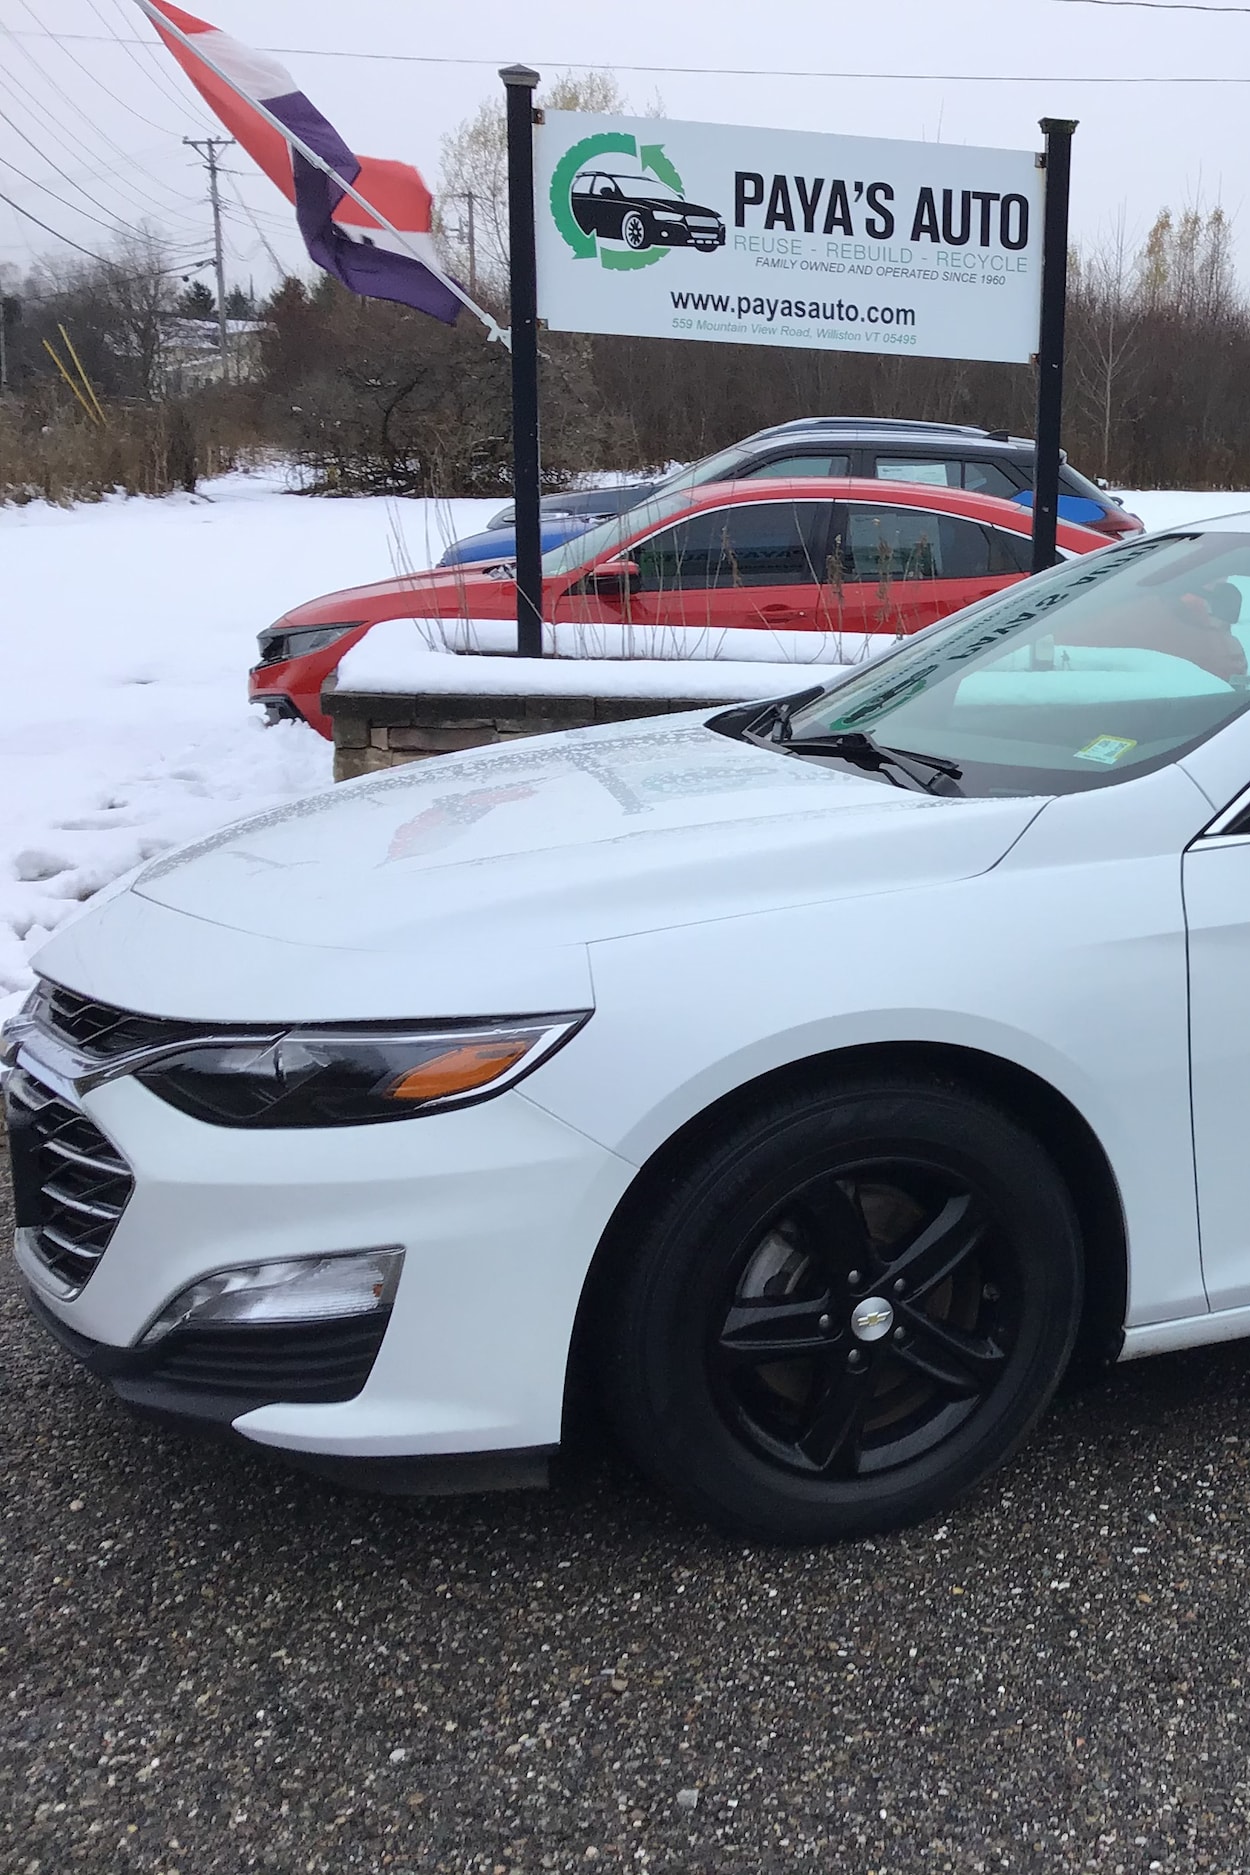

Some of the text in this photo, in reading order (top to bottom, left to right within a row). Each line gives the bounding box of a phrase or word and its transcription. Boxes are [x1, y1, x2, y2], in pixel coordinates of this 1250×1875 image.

[734, 171, 1029, 250] PAYA'S AUTO
[734, 234, 802, 255] REUSE
[826, 241, 913, 264] REBUILD
[936, 250, 1028, 273] RECYCLE
[755, 256, 1006, 286] FAMILY OWNED AND OPERATED SINCE 1960
[670, 290, 916, 326] www.payasauto.com
[671, 318, 918, 345] 559 Mountain View Road, Williston VT 05495
